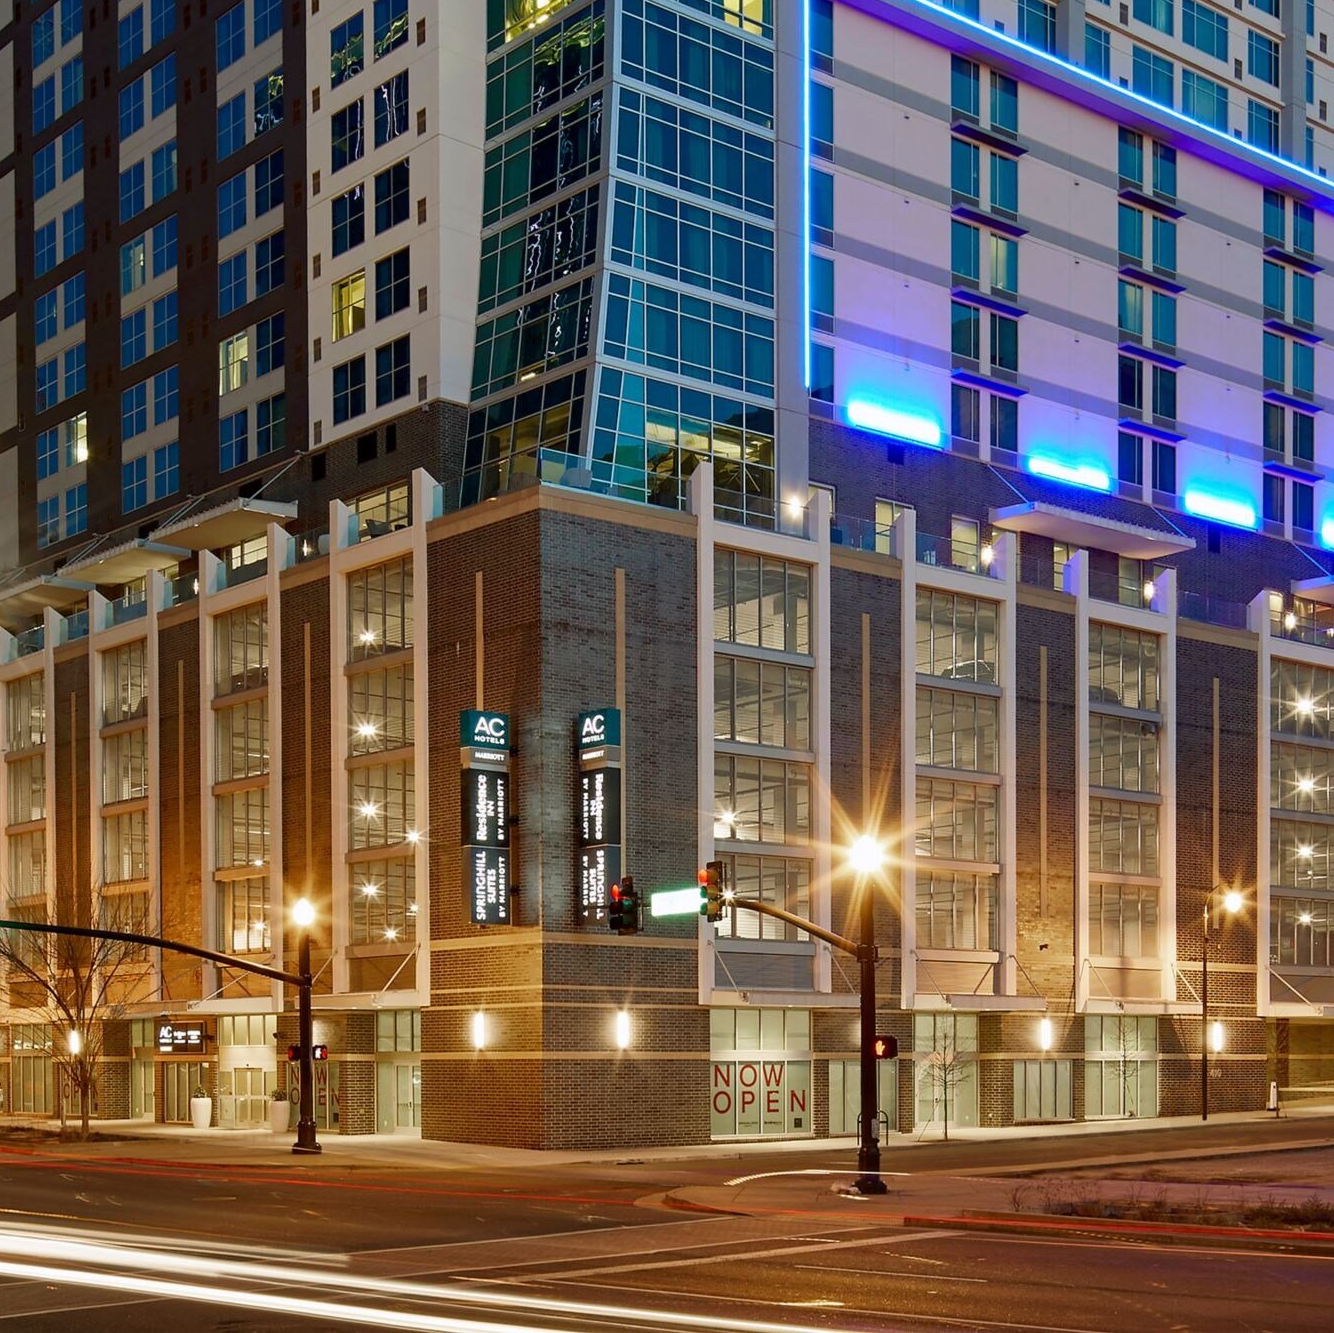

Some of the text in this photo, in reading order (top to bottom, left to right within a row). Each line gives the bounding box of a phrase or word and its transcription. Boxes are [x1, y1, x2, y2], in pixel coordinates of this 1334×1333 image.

[474, 716, 505, 737] AC
[582, 714, 605, 736] AC
[474, 735, 505, 745] HOTELS
[582, 734, 605, 744] HOTELS
[476, 774, 487, 841] Residence
[497, 778, 505, 840] BY MARRIOTT
[475, 850, 487, 921] SPRINGHILL
[487, 868, 497, 904] SUITES
[498, 856, 506, 918] BY MARRIOTT
[159, 1026, 173, 1038] AC
[291, 1066, 327, 1084] NW
[714, 1064, 784, 1087] NOW
[290, 1087, 340, 1106] OEN
[713, 1090, 806, 1114] OPEN
